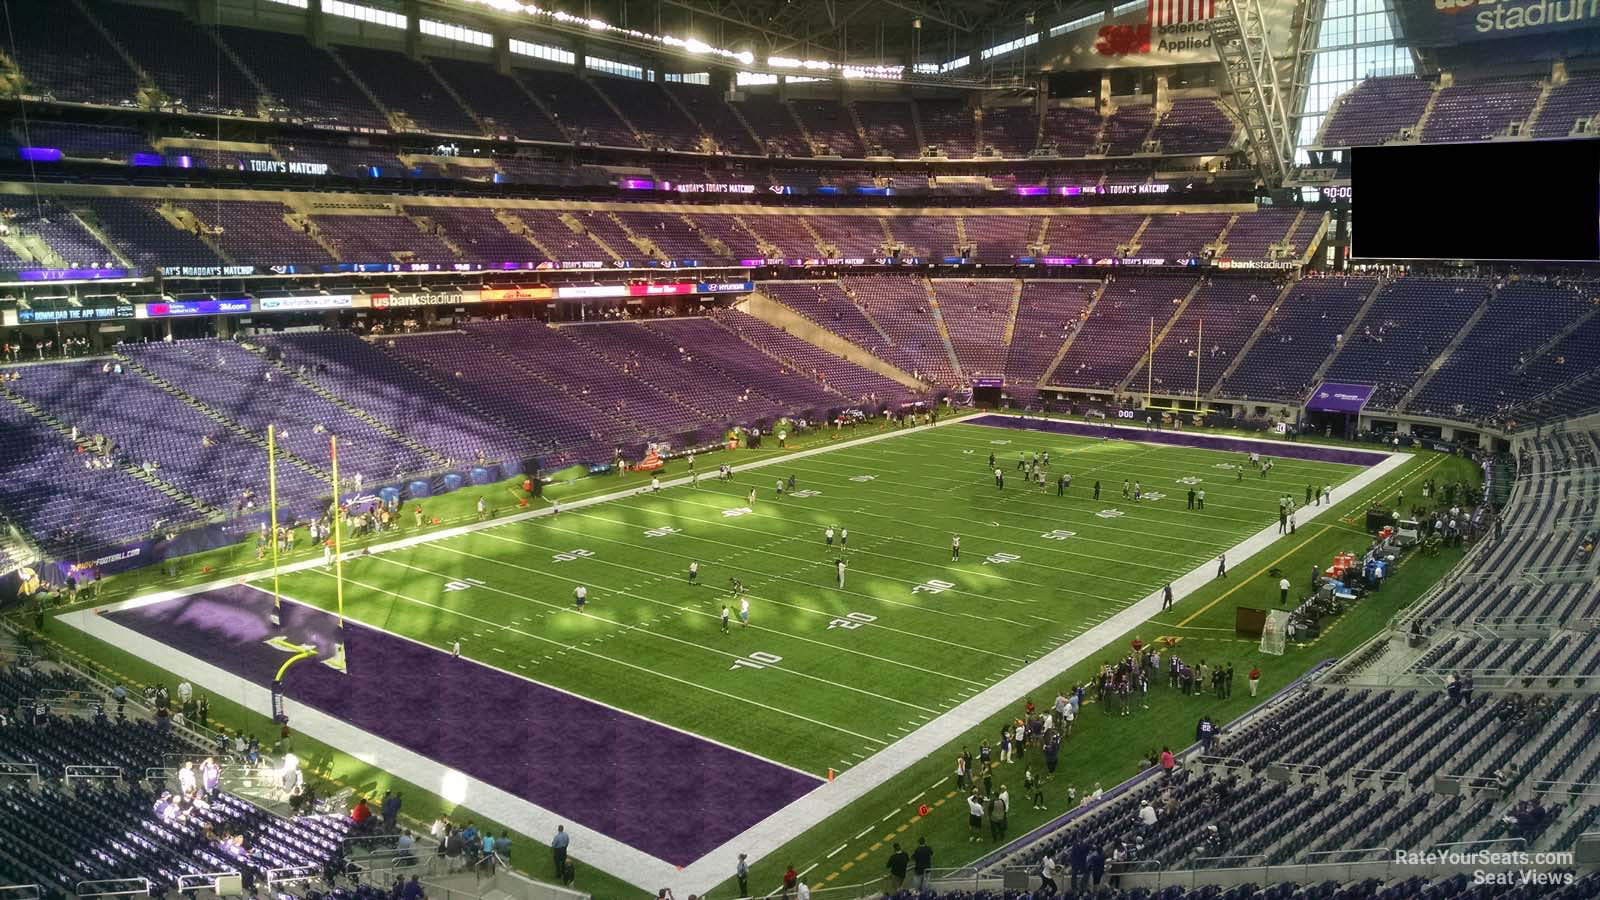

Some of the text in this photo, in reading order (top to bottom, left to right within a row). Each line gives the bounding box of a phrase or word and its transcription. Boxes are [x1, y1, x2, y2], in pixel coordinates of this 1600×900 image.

[1157, 36, 1212, 52] Applied
[250, 160, 328, 174] TODAY'S MATCHUP
[706, 184, 727, 192] TODAY'S
[729, 185, 754, 193] MATCHUP
[1110, 184, 1169, 194] TODAY'S MATCHUP
[223, 266, 254, 275] MATCHUP
[69, 310, 81, 319] THE
[82, 308, 94, 318] APP
[829, 612, 878, 629] 20
[733, 651, 784, 669] 10
